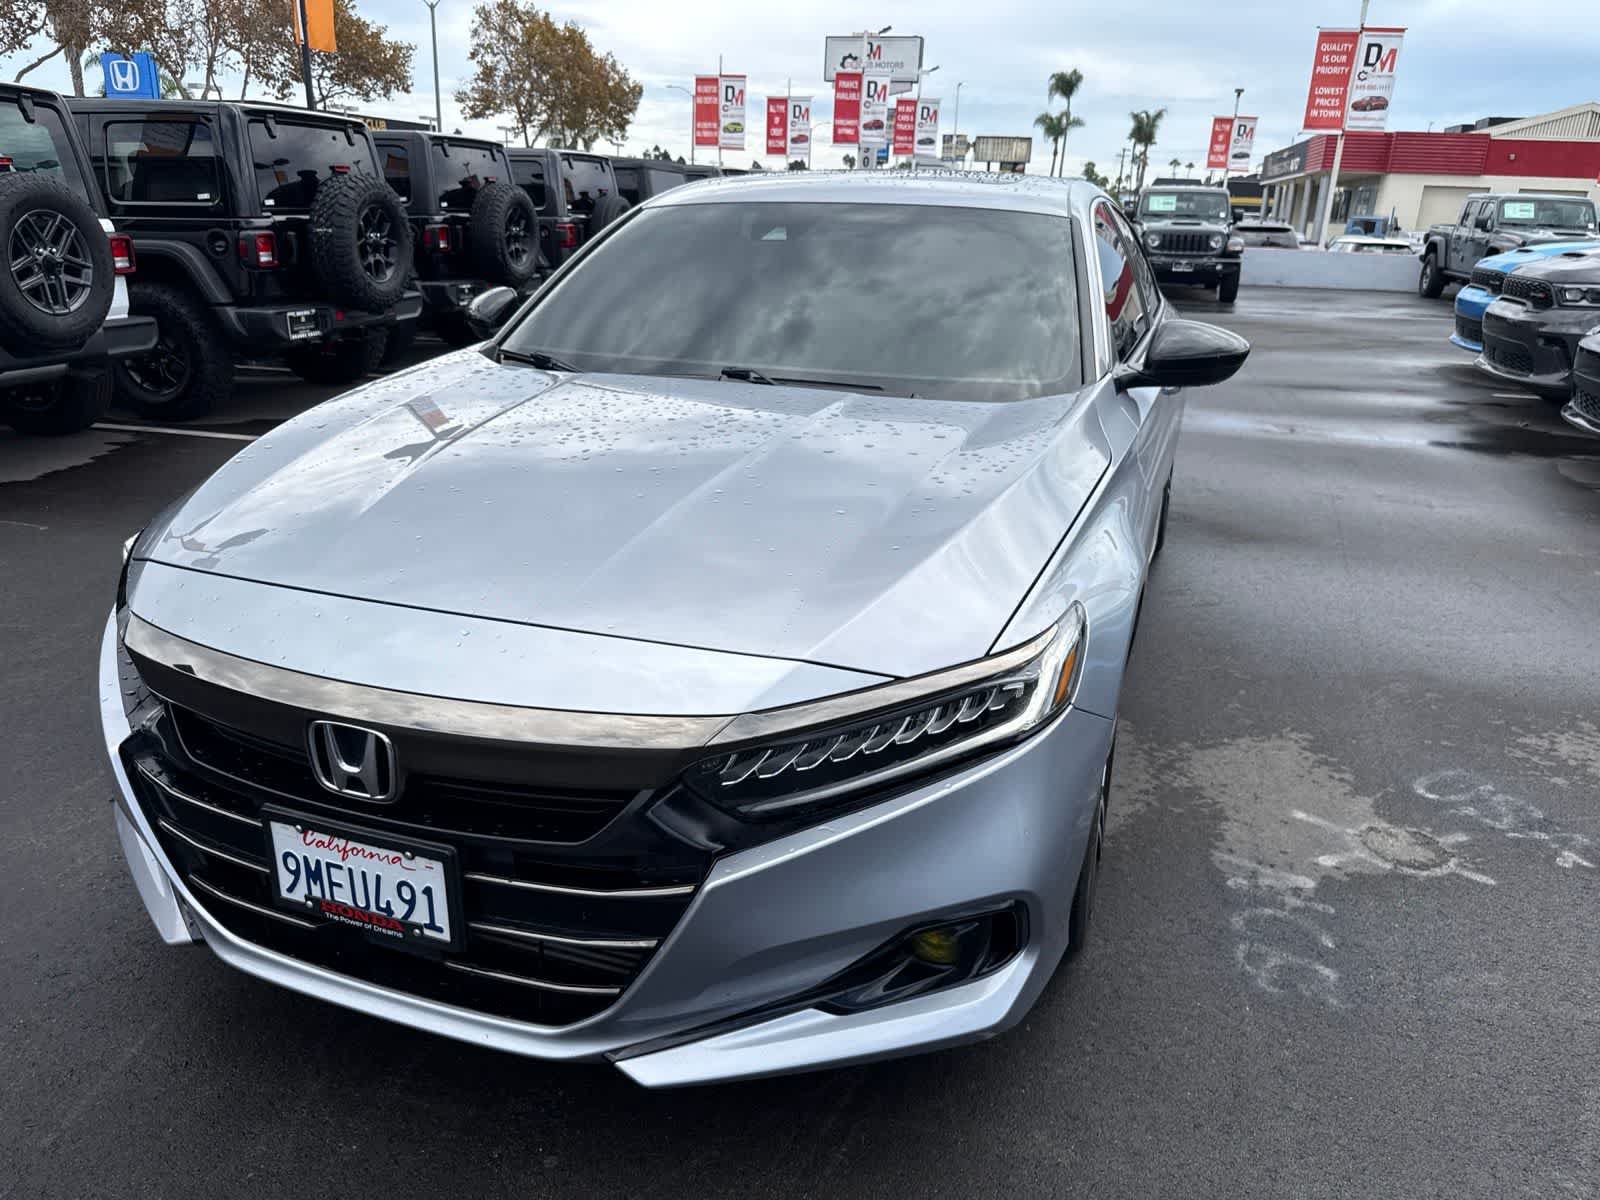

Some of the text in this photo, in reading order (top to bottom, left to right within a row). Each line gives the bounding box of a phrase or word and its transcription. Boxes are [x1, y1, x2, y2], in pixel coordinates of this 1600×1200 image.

[1321, 43, 1354, 52] QUALITY
[1322, 55, 1347, 63] IS OUR
[1315, 66, 1350, 75] PRIORITY
[1314, 87, 1345, 95] LOWEST
[1314, 98, 1340, 107] PRICES
[1310, 110, 1342, 118] IN TOWN
[302, 829, 416, 871] California
[320, 900, 405, 932] HONDA
[325, 912, 339, 921] The
[340, 915, 363, 927] Power
[373, 925, 404, 938] Dreams
